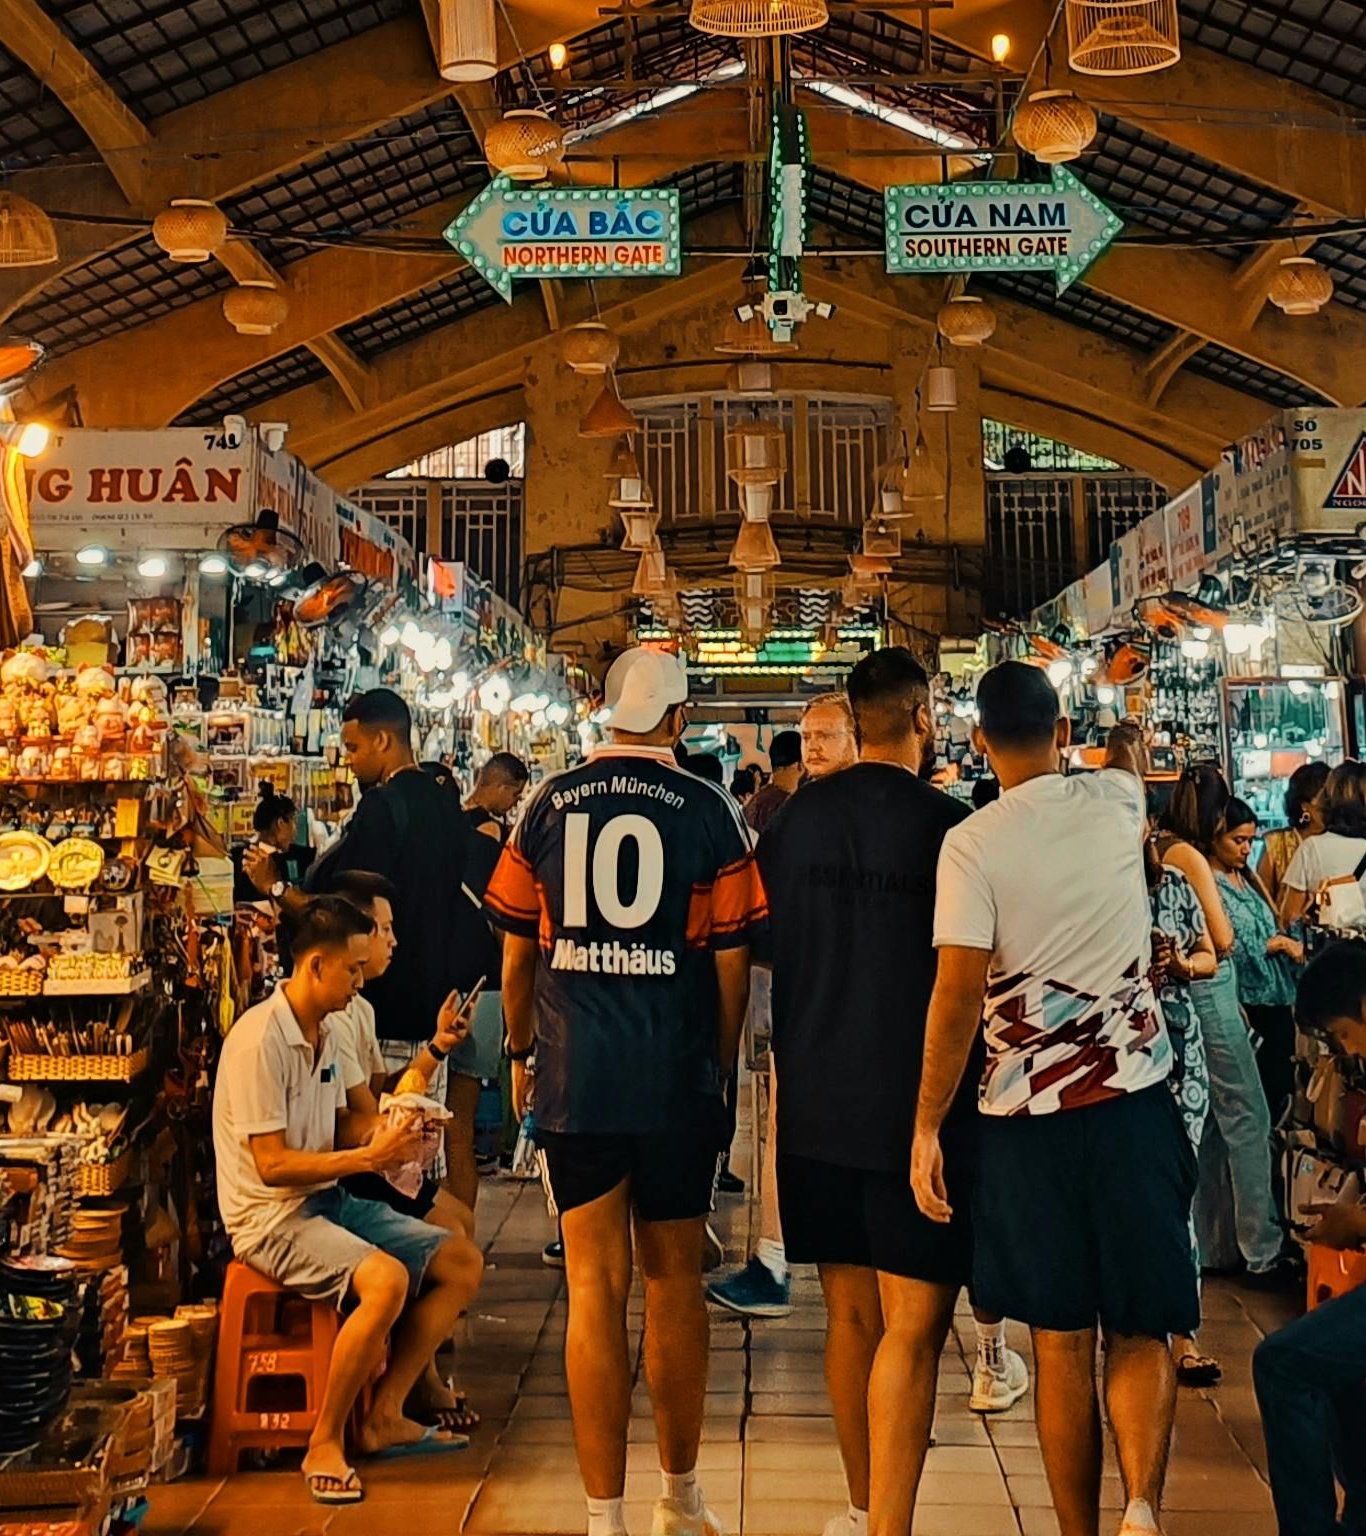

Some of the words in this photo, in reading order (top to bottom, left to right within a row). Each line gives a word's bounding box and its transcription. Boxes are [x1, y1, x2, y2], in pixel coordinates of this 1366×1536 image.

[503, 201, 577, 237] CỬA
[589, 199, 663, 237] BẮC
[905, 196, 977, 228] CỬA
[989, 203, 1066, 227] NAM
[504, 246, 607, 266] NORTHERN
[615, 245, 663, 265] GATE
[905, 238, 1011, 258] SOUTHERN
[1018, 236, 1068, 256] GATE
[1290, 438, 1323, 451] 705
[86, 457, 242, 503] HUÂN
[551, 780, 608, 810] Bayern
[611, 776, 686, 810] München
[563, 813, 664, 930] 10
[550, 939, 676, 976] Matthäus
